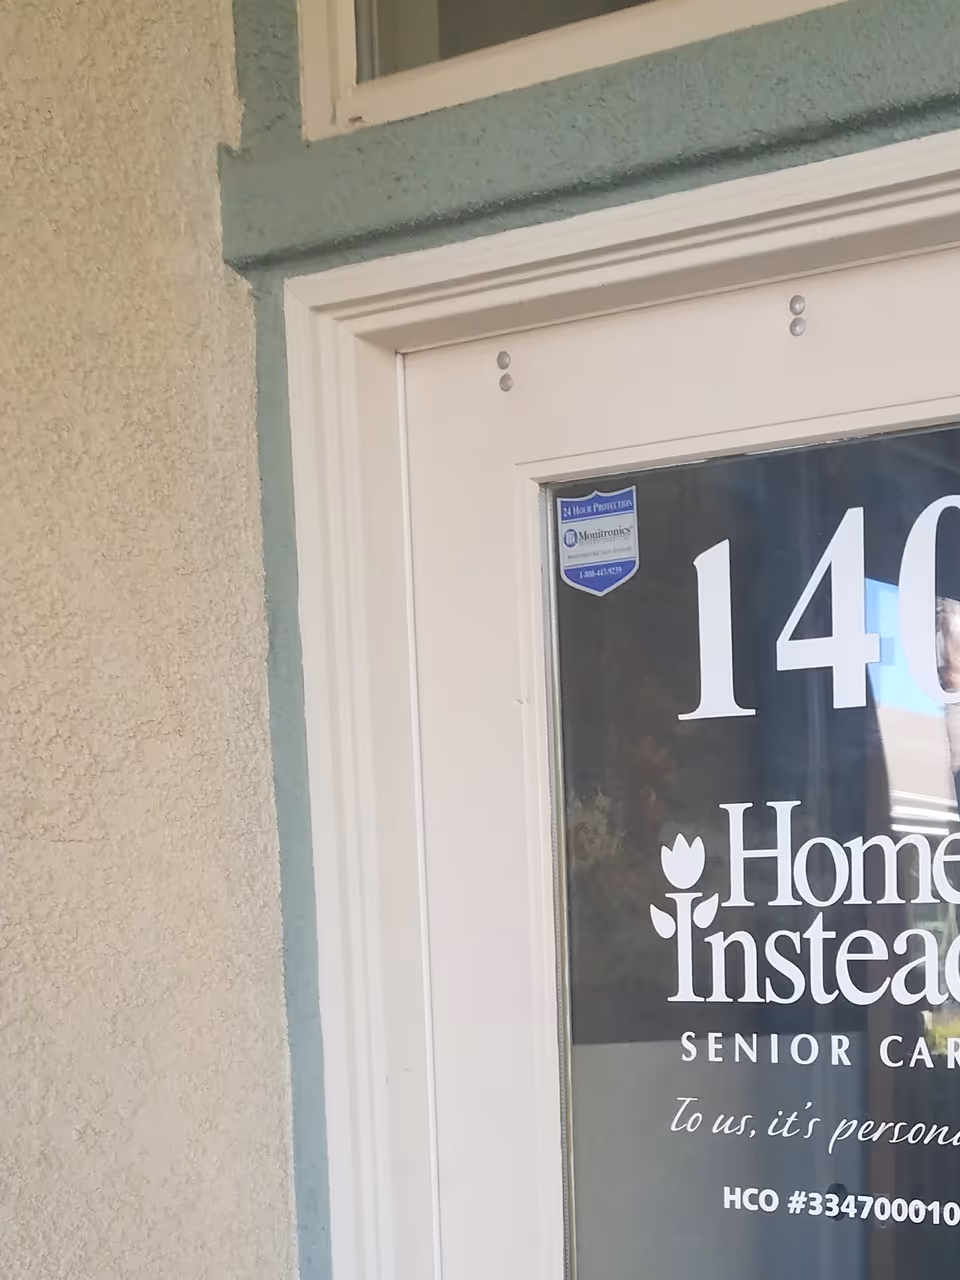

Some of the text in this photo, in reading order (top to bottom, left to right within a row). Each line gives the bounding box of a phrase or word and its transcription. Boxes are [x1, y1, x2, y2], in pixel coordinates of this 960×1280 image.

[681, 1032, 851, 1066] SENIOR
[670, 1097, 702, 1132] To
[712, 1113, 755, 1138] us,
[767, 1101, 820, 1139] it's
[723, 1186, 960, 1226] HCO #334700010
